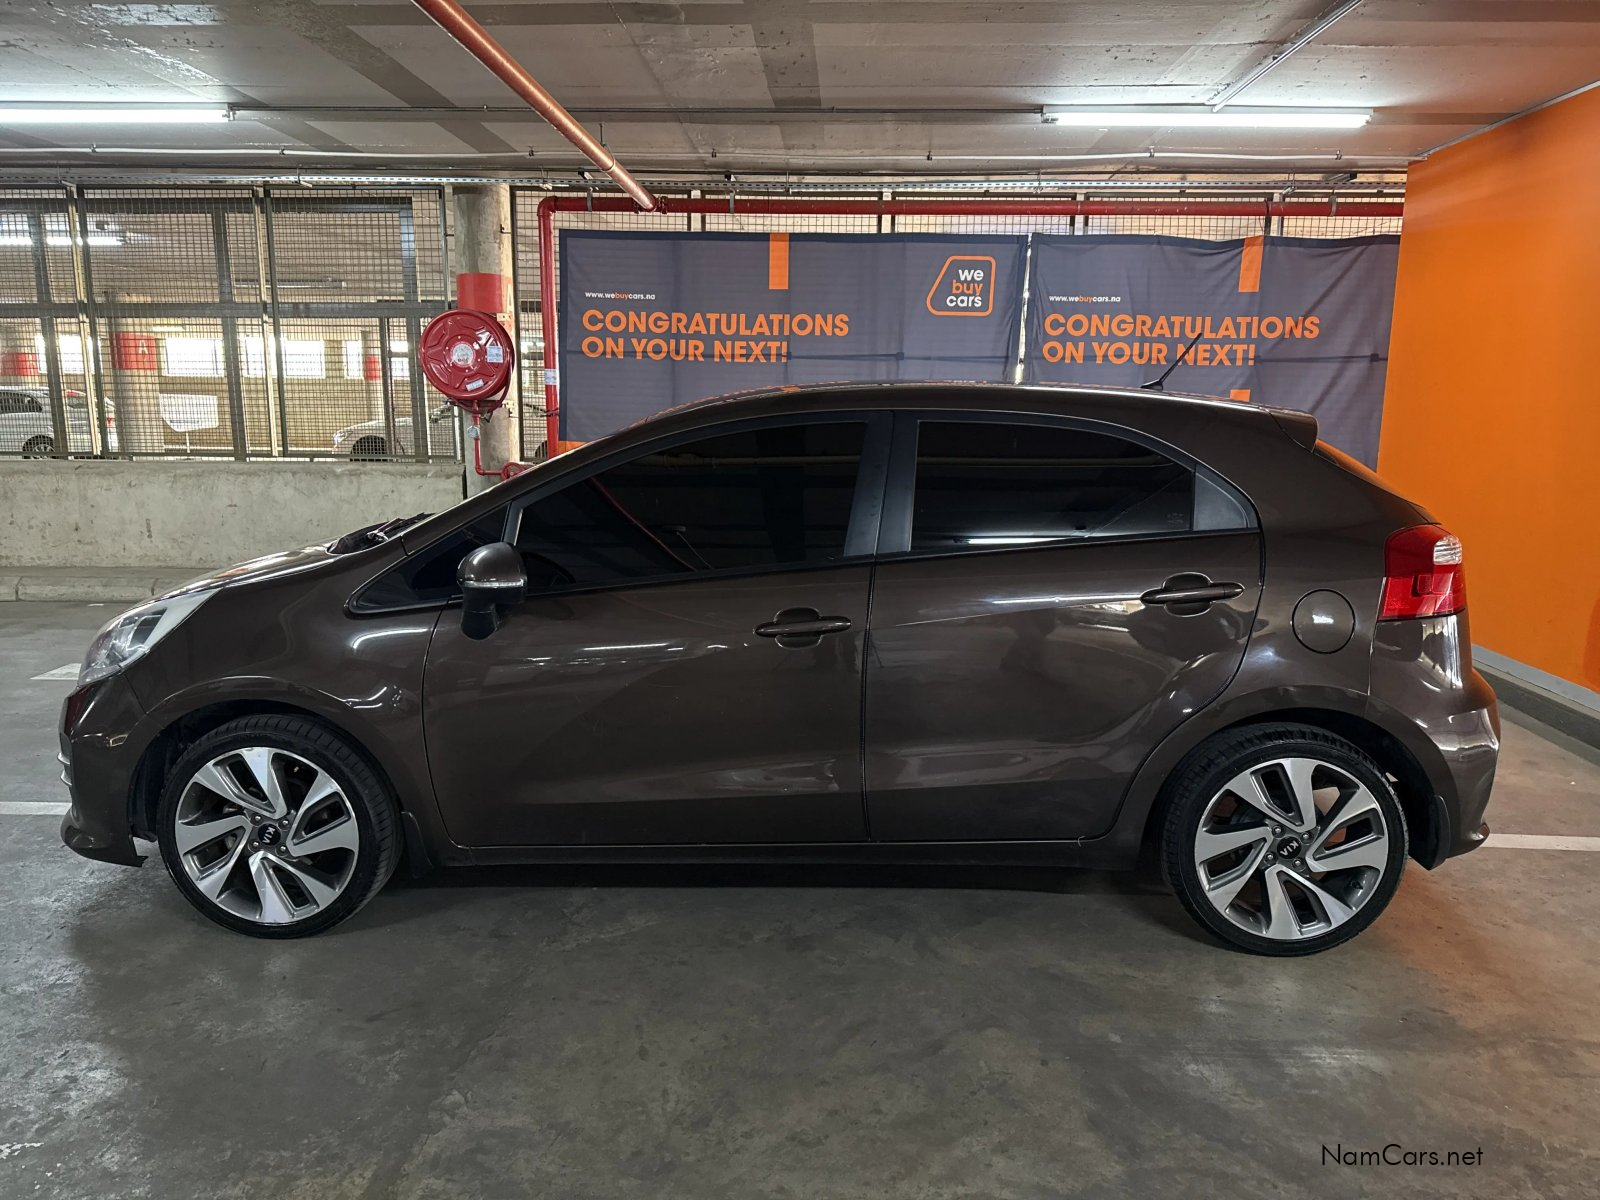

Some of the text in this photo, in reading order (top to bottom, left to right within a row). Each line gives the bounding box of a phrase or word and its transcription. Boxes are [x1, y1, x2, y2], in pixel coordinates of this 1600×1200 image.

[958, 269, 985, 281] we
[585, 291, 656, 301] www.webuycars.na
[952, 279, 983, 296] buy
[946, 295, 982, 307] cars
[1048, 295, 1121, 303] www.webuycars.na
[582, 309, 849, 337] CONGRATULATIONS
[1044, 313, 1320, 339] CONGRATULATIONS
[581, 336, 788, 363] ON YOUR NEXT!
[1042, 341, 1256, 366] ON YOUR NEXT!
[262, 826, 276, 844] KIA
[1279, 840, 1299, 856] KIA
